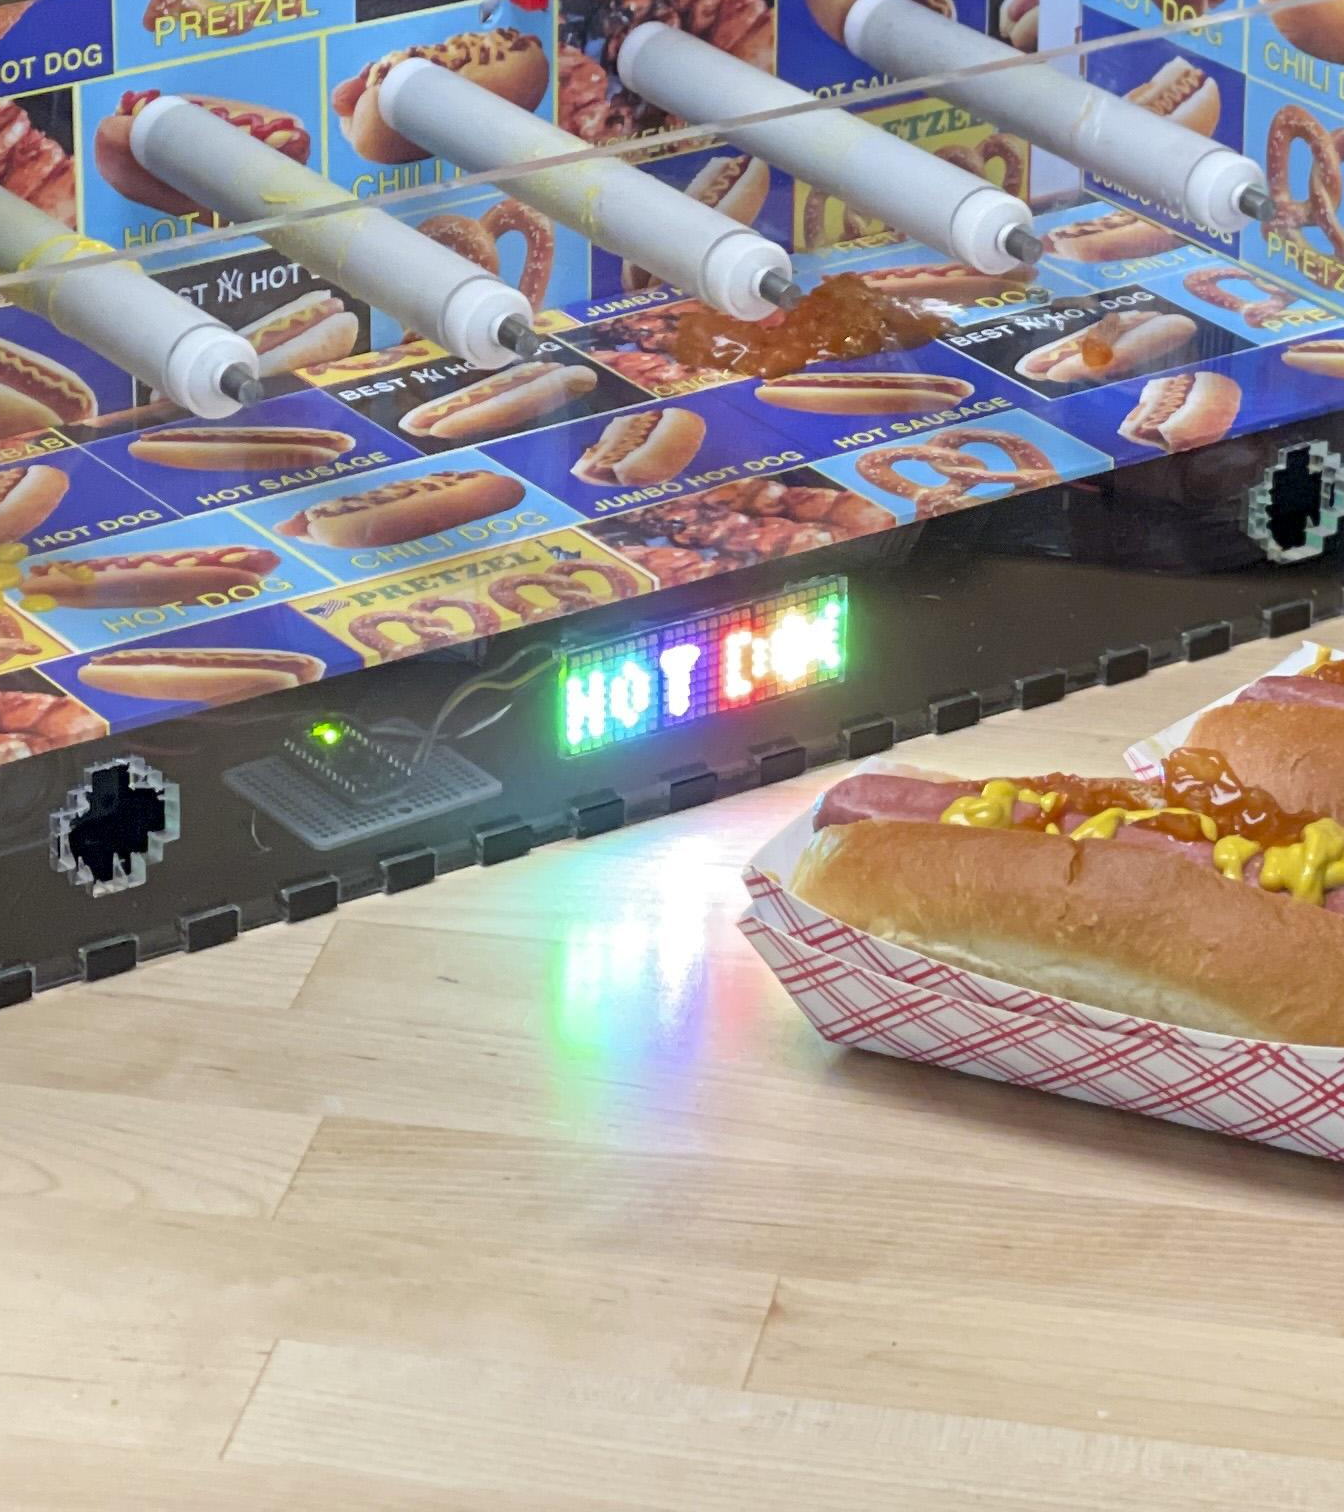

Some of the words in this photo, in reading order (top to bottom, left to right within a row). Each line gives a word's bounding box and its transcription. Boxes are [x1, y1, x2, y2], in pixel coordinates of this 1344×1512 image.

[44, 43, 104, 76] DOG
[1263, 42, 1331, 93] CHILI
[124, 211, 200, 251] HOT
[250, 263, 301, 294] HOT
[585, 291, 670, 318] JUMBO
[949, 324, 1014, 348] BEST
[1101, 291, 1155, 311] DOG
[339, 375, 406, 403] BEST
[833, 427, 888, 450] HOT
[890, 396, 1014, 435] SAUSAGE
[196, 484, 254, 507] HOT
[258, 451, 393, 491] SAUSAGE
[593, 480, 684, 514] JUMBO
[687, 465, 740, 488] HOT
[743, 450, 804, 474] DOG
[32, 524, 92, 549] HOT
[97, 509, 163, 532] DOG
[350, 533, 451, 571] CHILI
[460, 509, 551, 543] DOG
[101, 600, 189, 634] HOT
[196, 576, 295, 610] DOG
[346, 547, 543, 609] PRETZEL
[564, 643, 702, 746] HOT
